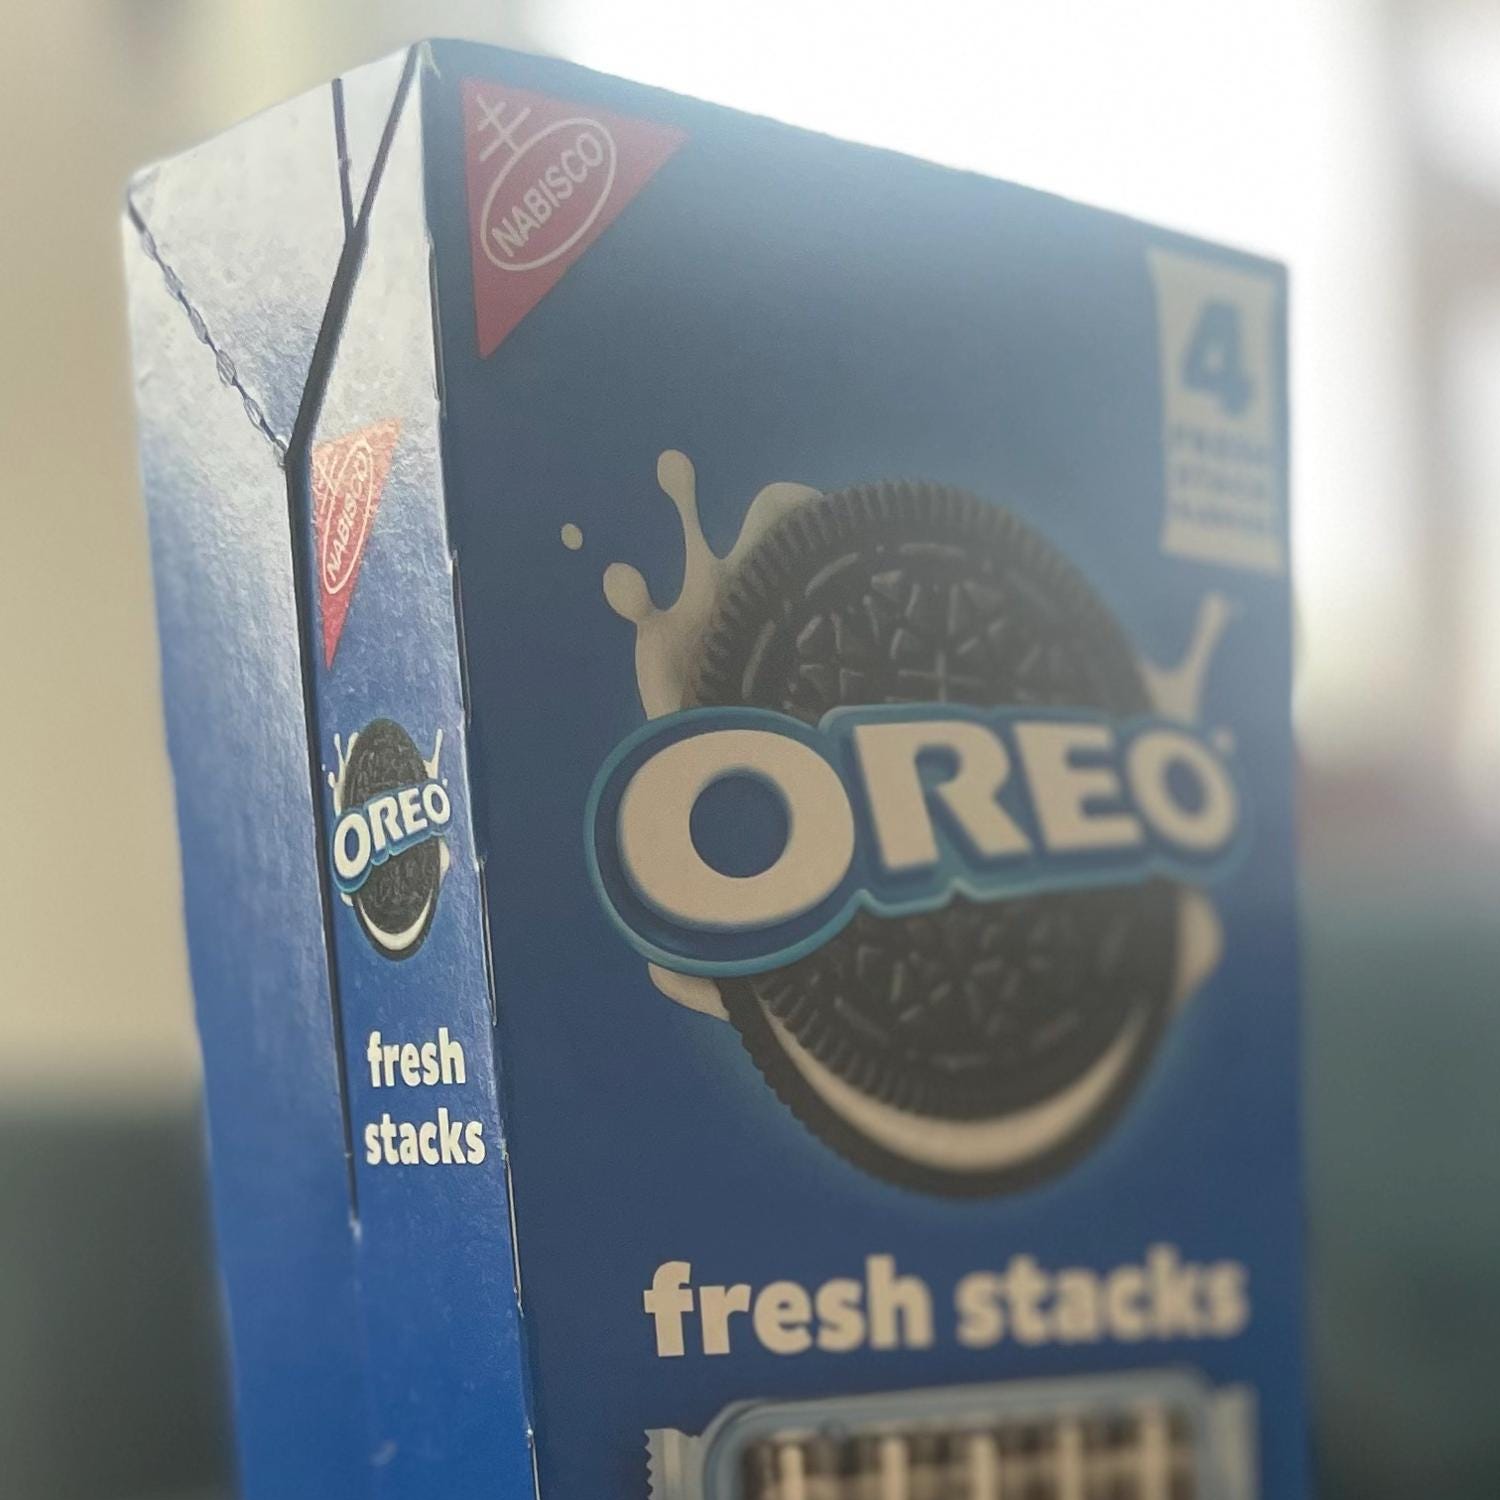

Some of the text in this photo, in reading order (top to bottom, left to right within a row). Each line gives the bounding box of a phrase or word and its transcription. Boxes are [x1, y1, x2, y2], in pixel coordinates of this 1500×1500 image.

[491, 132, 604, 257] NABISCO
[1181, 299, 1256, 418] 4
[326, 450, 368, 582] NABISCO
[333, 783, 450, 879] OREO
[619, 720, 1239, 926] OREO
[367, 1027, 466, 1088] fresh
[365, 1107, 485, 1166] stacks
[643, 1241, 1250, 1357] fresh stacks
